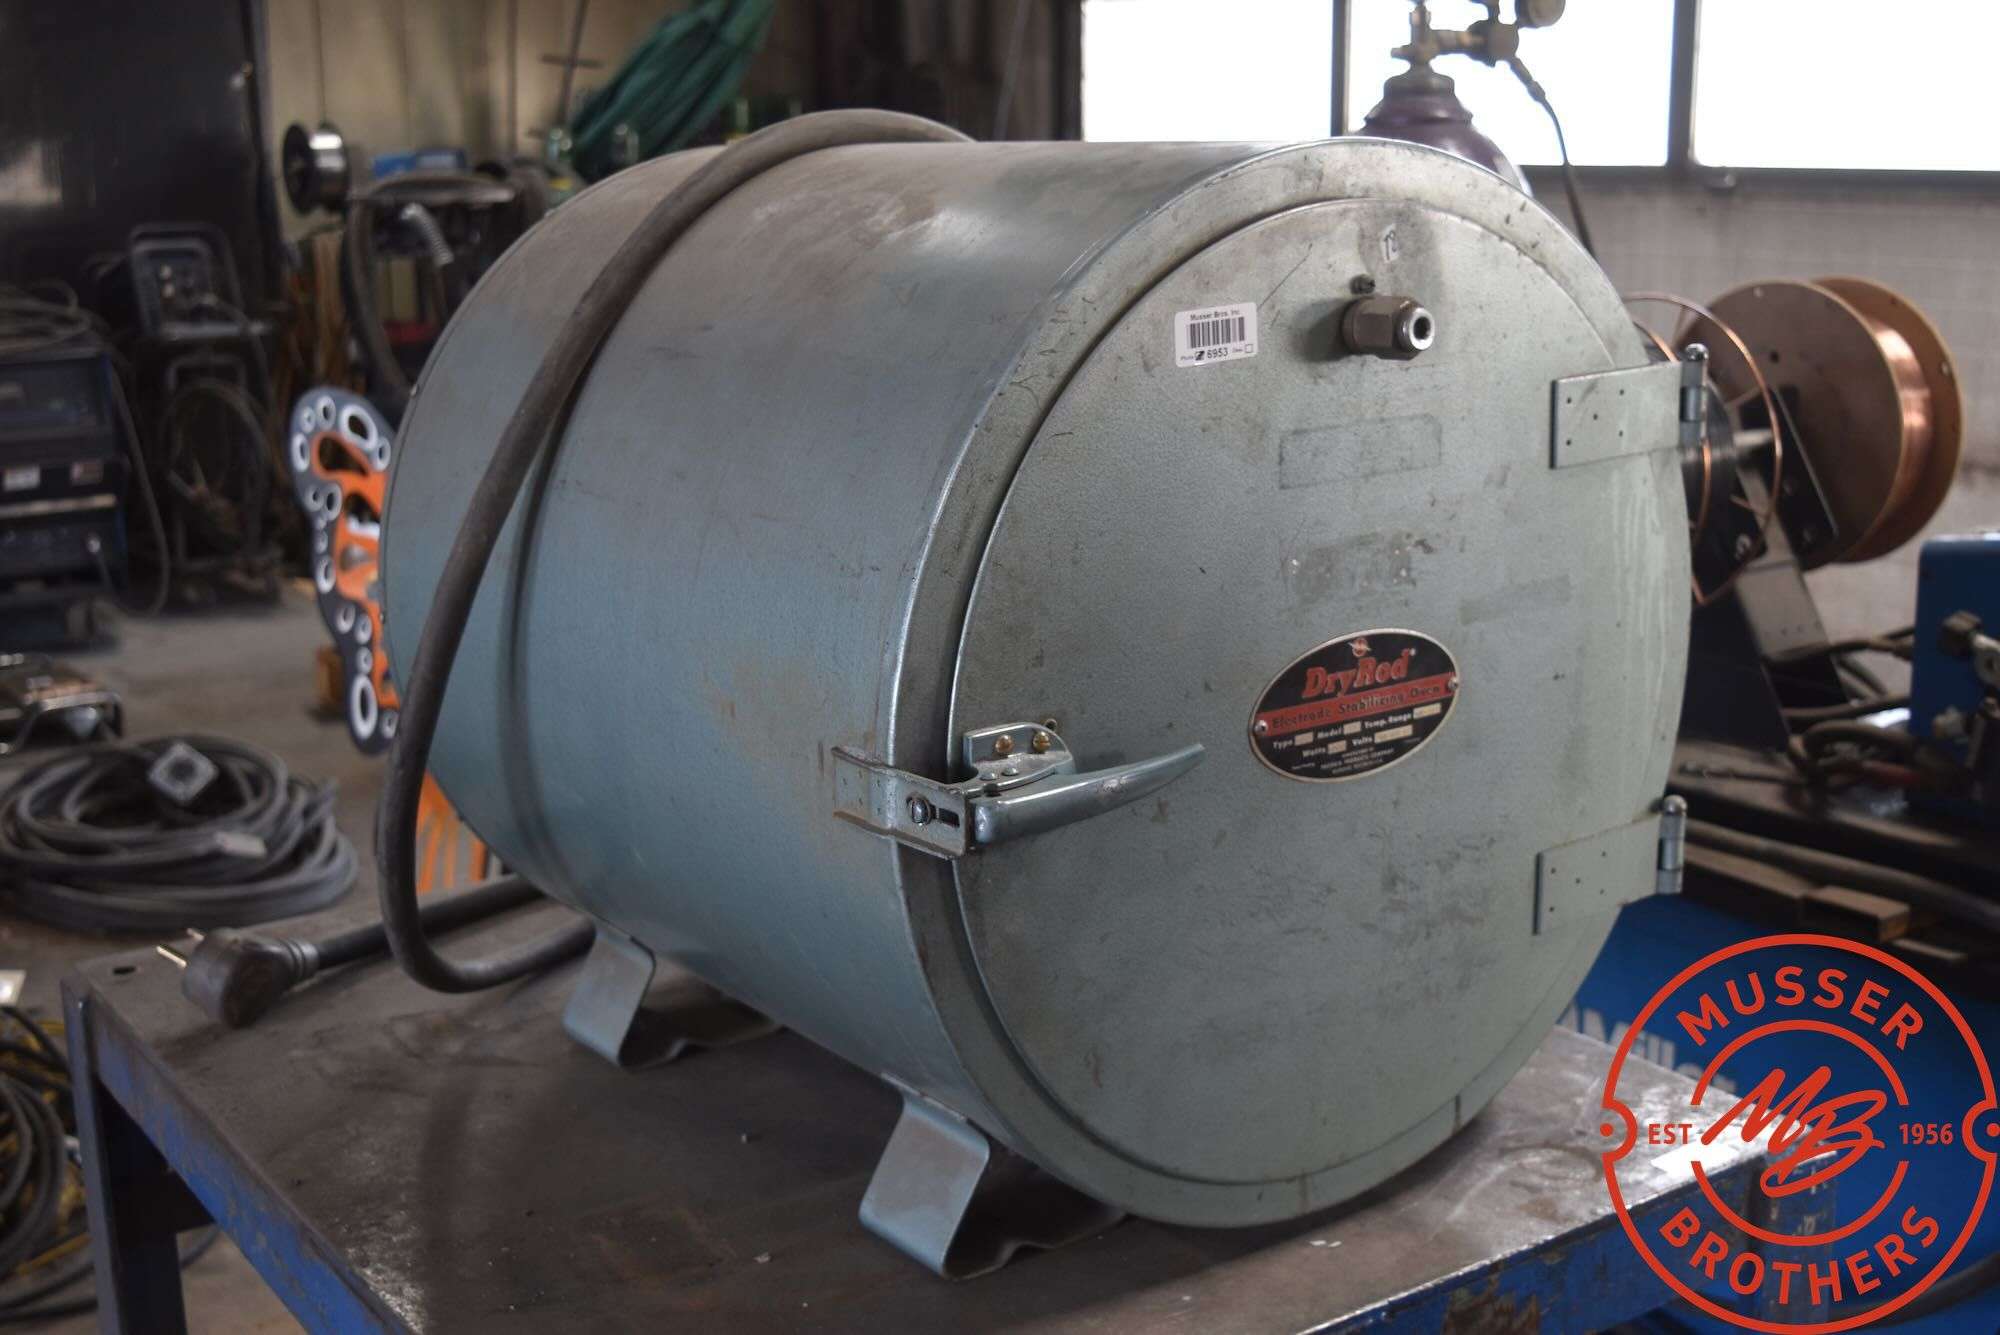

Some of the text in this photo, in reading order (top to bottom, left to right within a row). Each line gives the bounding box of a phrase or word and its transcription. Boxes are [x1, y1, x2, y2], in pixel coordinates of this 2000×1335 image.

[1207, 347, 1228, 359] 6953
[1301, 648, 1410, 699] DryRod
[1271, 685, 1440, 729] Electrode Stabilizing Oven
[1273, 739, 1293, 750] Type
[1317, 727, 1343, 739] Model
[1352, 737, 1373, 746] Volts
